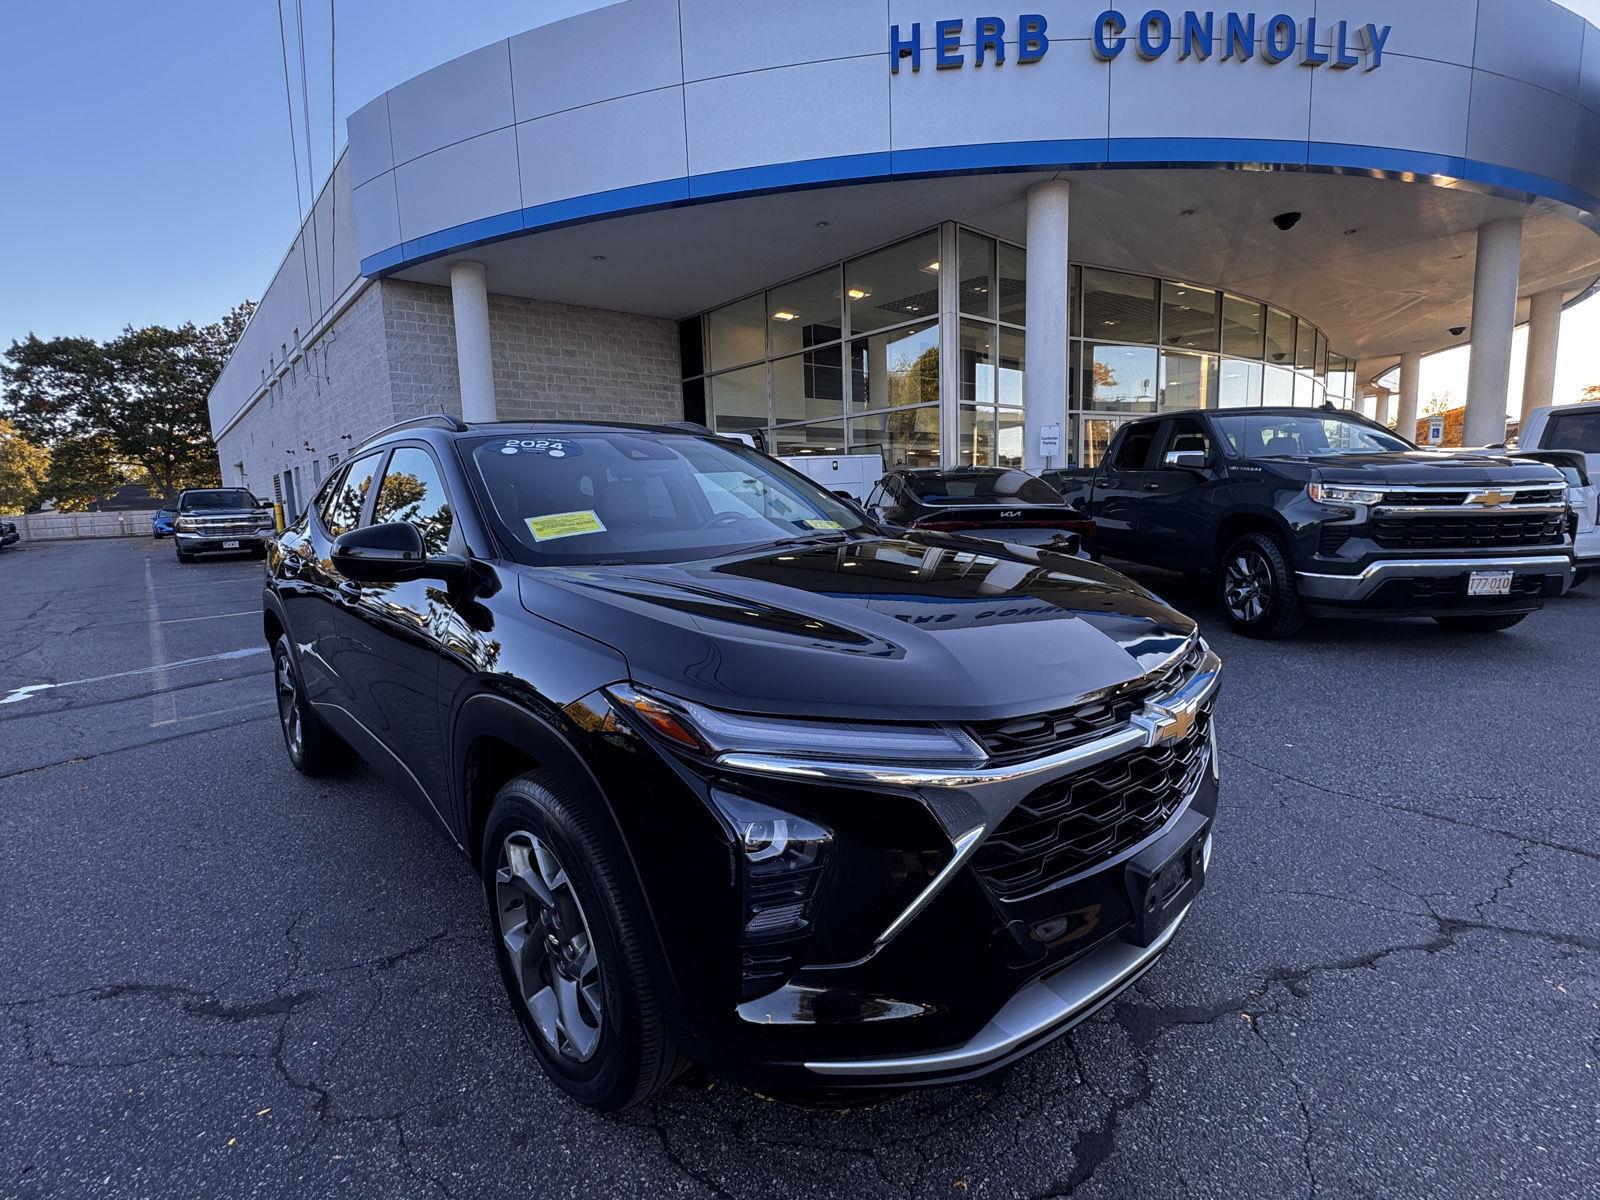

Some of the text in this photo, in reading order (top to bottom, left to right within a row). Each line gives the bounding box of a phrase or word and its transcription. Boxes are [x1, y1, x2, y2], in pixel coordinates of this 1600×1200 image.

[890, 9, 1391, 73] HERB CONNOLLY
[505, 439, 563, 450] 2024
